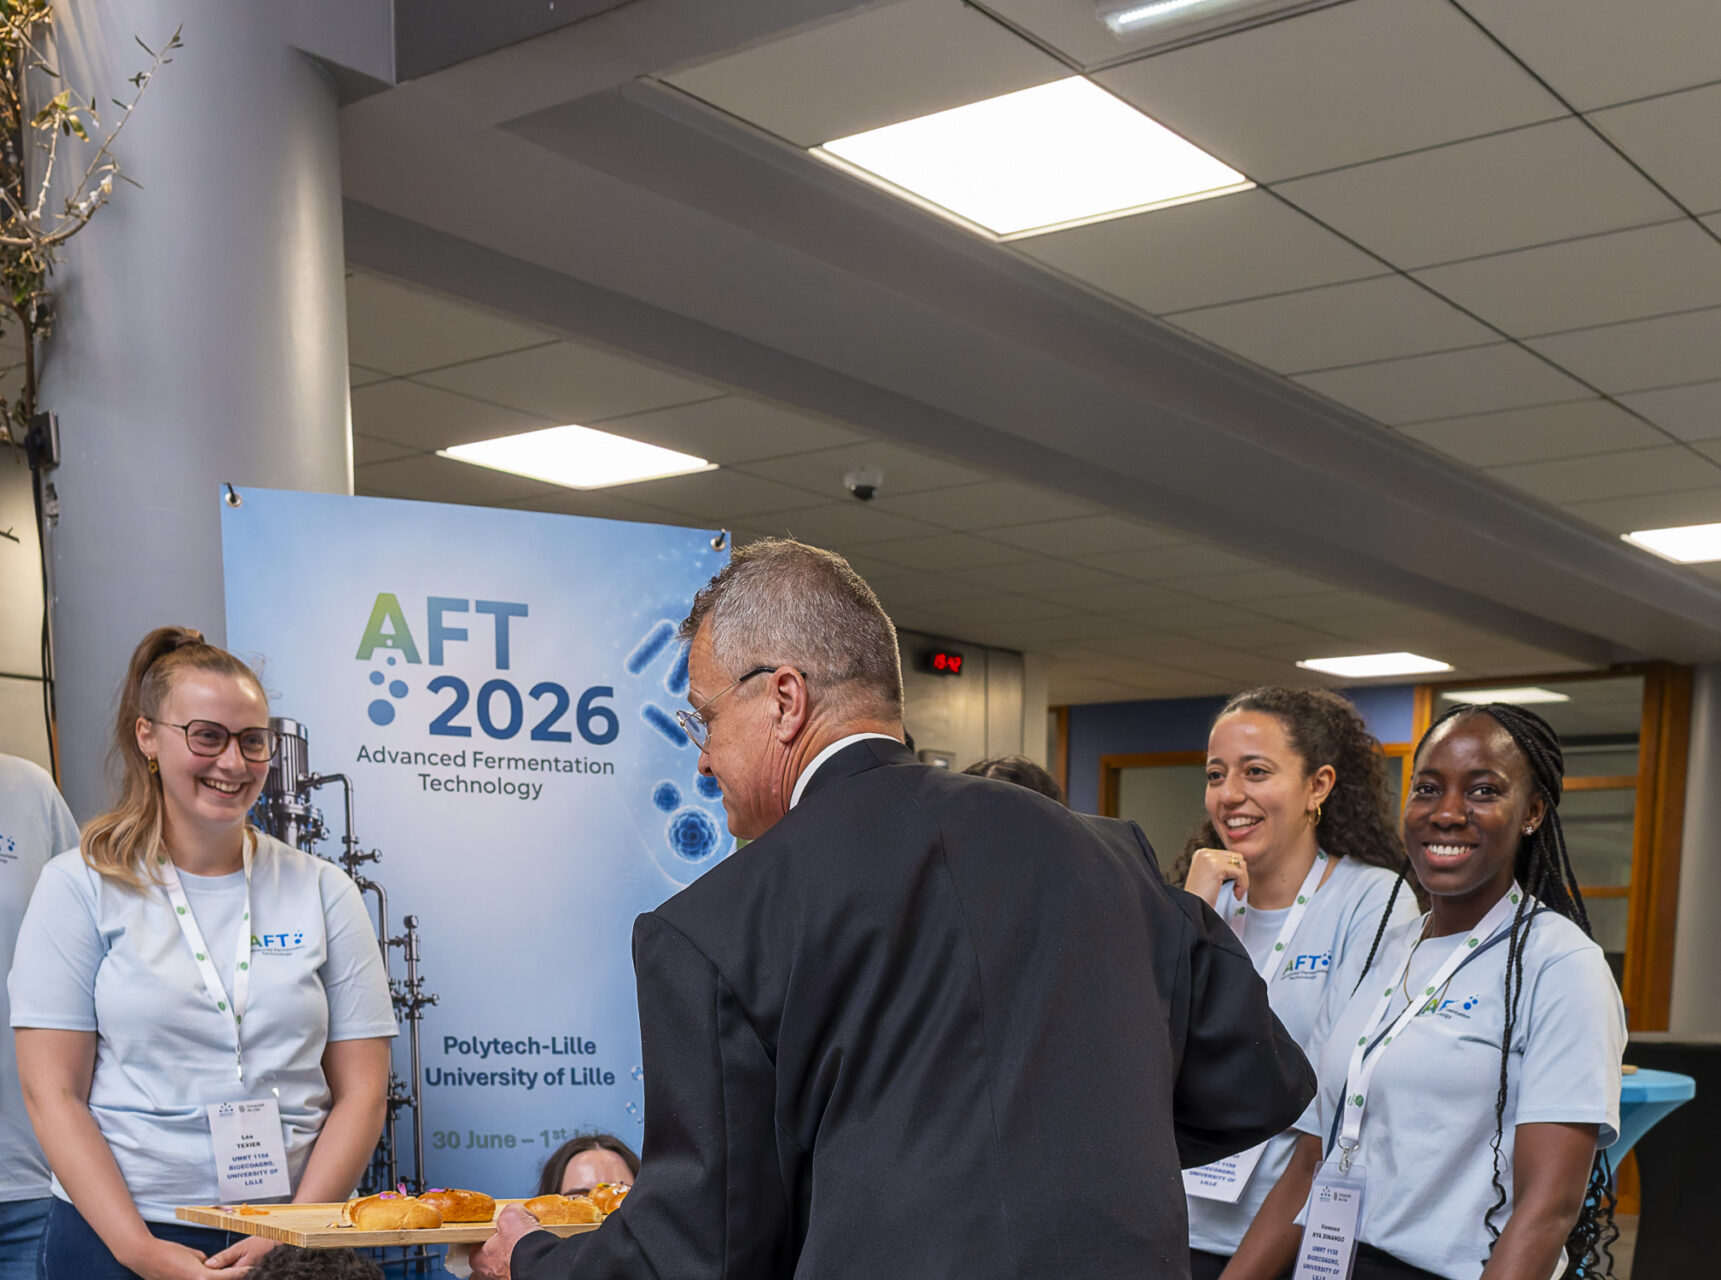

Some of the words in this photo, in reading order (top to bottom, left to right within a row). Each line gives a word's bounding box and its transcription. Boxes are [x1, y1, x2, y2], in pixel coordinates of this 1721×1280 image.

[355, 592, 529, 670] AFT
[426, 675, 620, 746] 2026
[356, 744, 467, 768] Advanced
[472, 751, 615, 776] Fermentation
[418, 773, 543, 801] Technology
[250, 933, 289, 947] AFT
[443, 1036, 597, 1059] Polytech-Lille
[425, 1067, 538, 1090] University
[543, 1067, 565, 1086] of
[571, 1067, 615, 1086] Lille
[433, 1130, 460, 1149] 30
[465, 1130, 516, 1149] June
[226, 1170, 268, 1180] UNIVERSITY
[1303, 1263, 1332, 1273] UNIVERSITY
